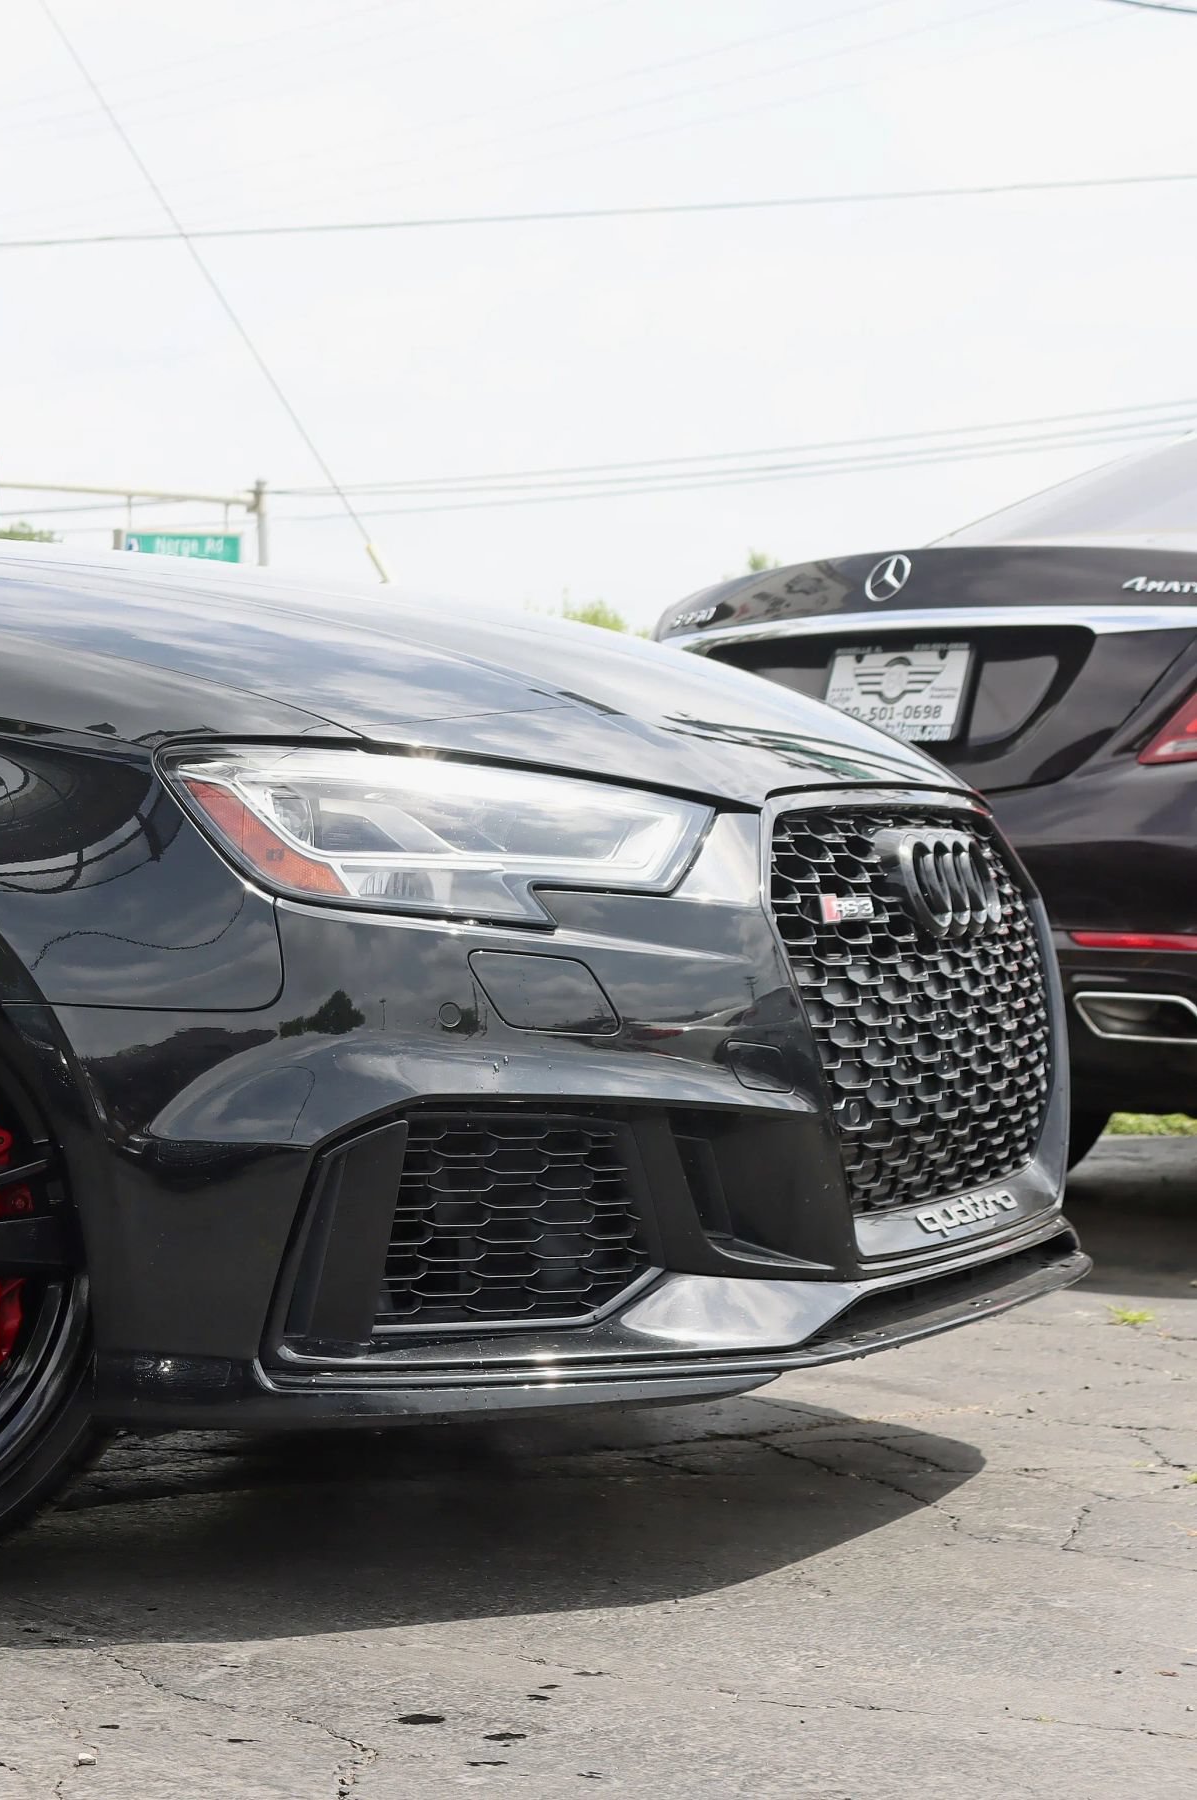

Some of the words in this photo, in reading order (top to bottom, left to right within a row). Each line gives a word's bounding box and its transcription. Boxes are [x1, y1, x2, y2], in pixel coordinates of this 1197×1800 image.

[205, 536, 224, 554] Rd
[843, 704, 943, 721] 0-501-0698
[831, 900, 874, 919] RS3
[916, 1190, 1019, 1237] quattro
